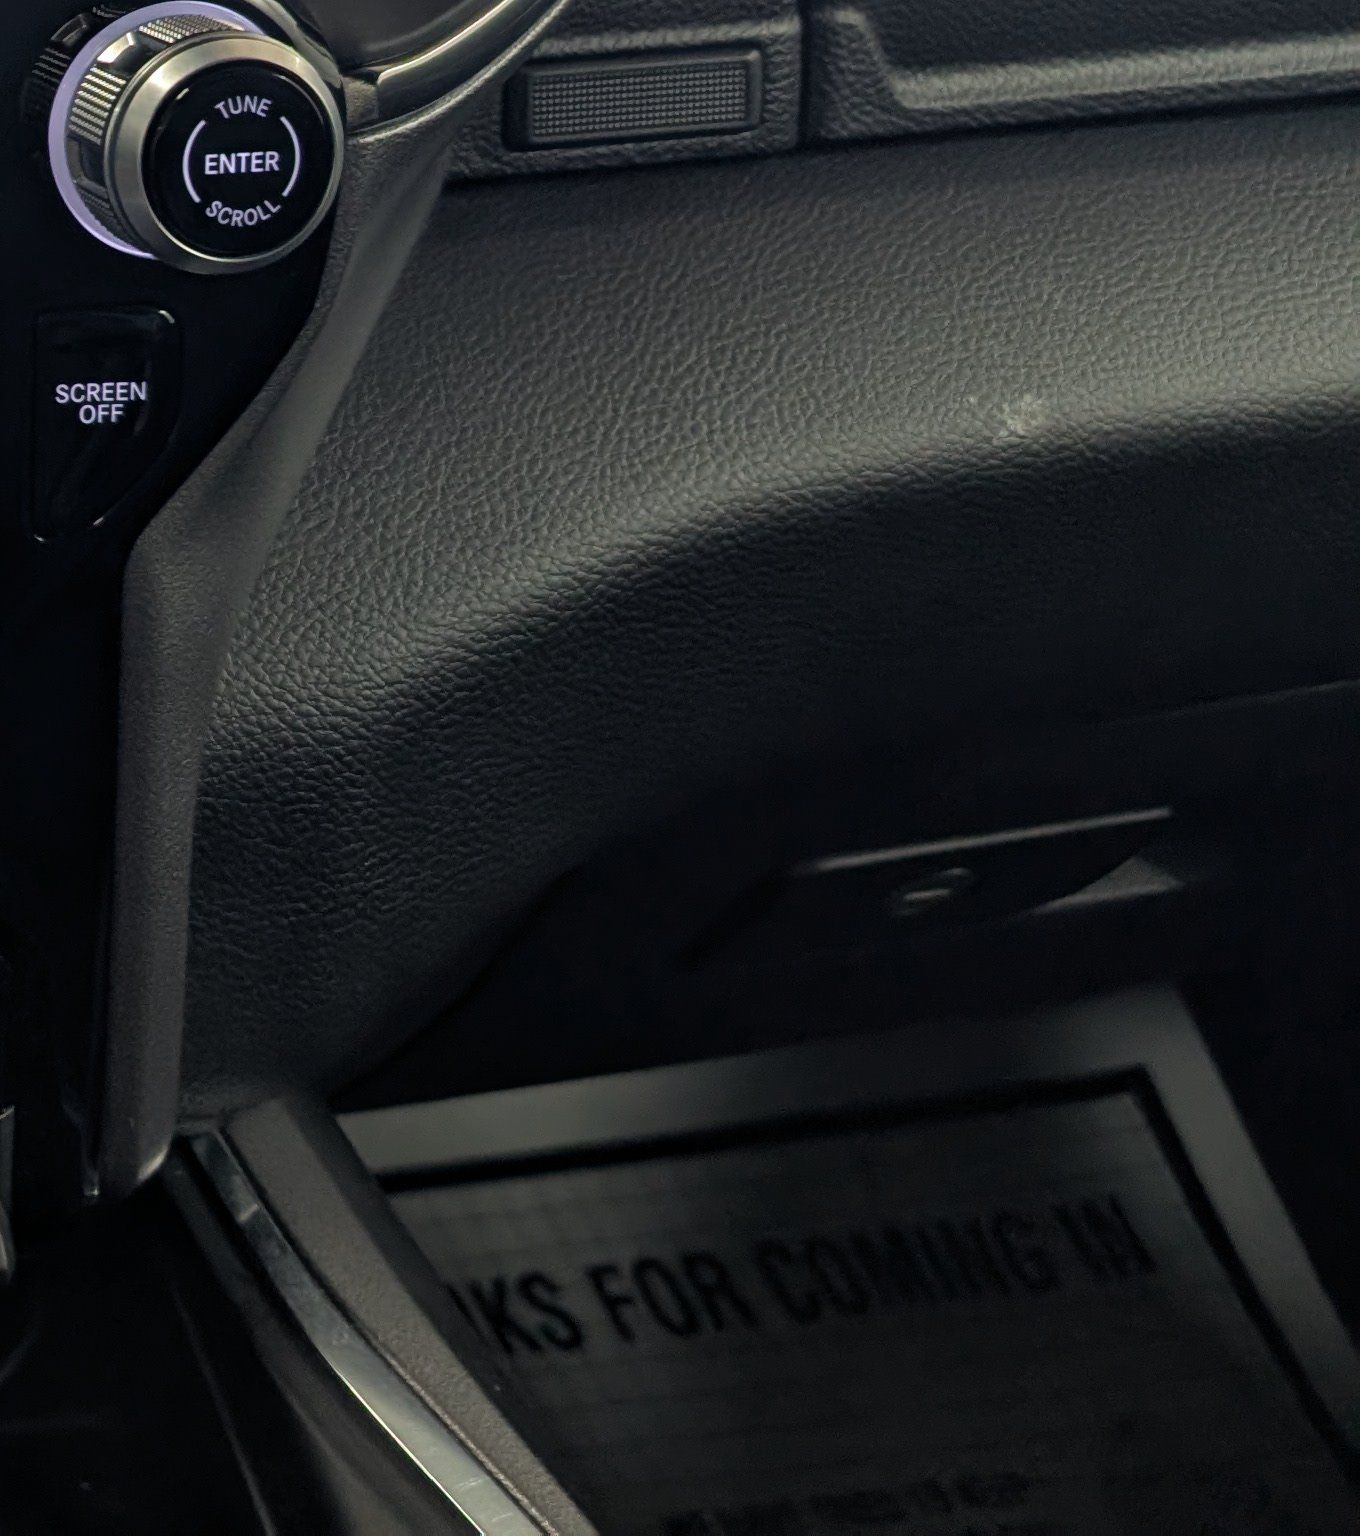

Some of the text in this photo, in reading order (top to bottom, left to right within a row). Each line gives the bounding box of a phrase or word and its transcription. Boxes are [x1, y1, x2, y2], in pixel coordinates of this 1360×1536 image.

[214, 95, 272, 119] TUNE
[204, 151, 279, 175] ENTER
[204, 196, 282, 230] SCROLL
[55, 381, 147, 404] SCREEN
[77, 402, 126, 426] OFF
[592, 1248, 754, 1344] FOR
[758, 1208, 1052, 1326] COMING
